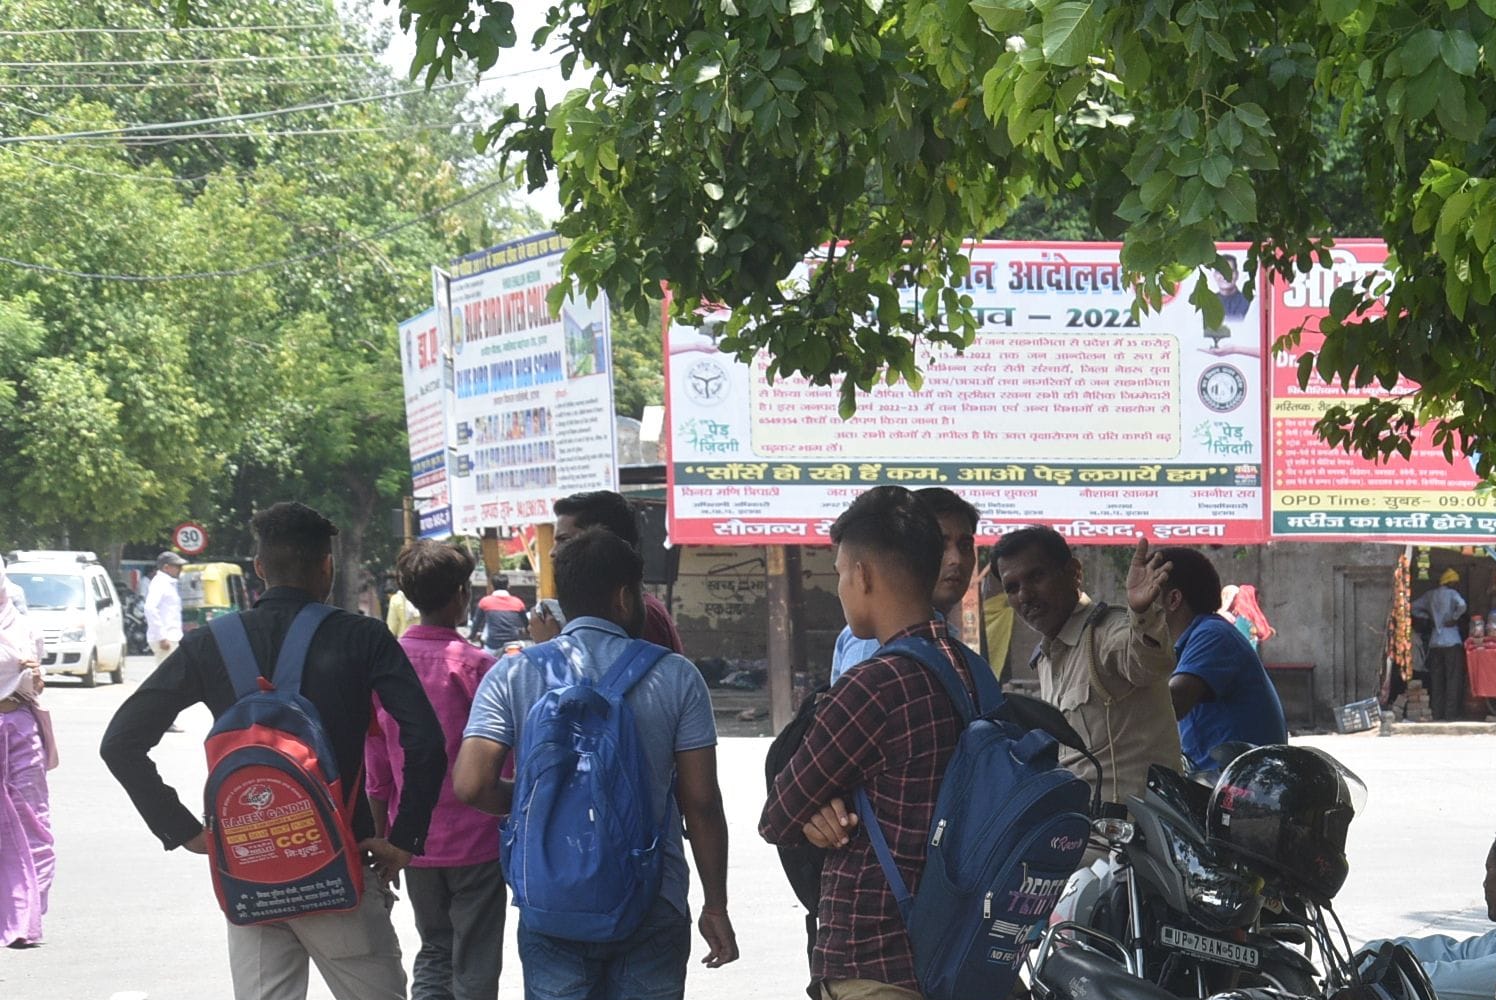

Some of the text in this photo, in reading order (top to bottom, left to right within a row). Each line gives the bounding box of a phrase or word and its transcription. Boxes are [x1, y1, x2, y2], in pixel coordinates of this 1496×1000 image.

[1066, 308, 1141, 328] 2022
[773, 463, 801, 481] हो
[809, 463, 850, 481] रही
[858, 463, 882, 482] हैं
[957, 464, 1026, 482] आओ
[1033, 465, 1073, 485] पेड़
[1078, 464, 1162, 482] लगायें
[1281, 495, 1321, 506] OPD
[1327, 494, 1376, 506] Time:
[712, 519, 807, 536] सौजन्य
[1153, 522, 1226, 537] इटावा
[1287, 512, 1345, 528] मरीज
[1349, 516, 1380, 528] का
[1384, 512, 1430, 529] भर्ती
[1432, 513, 1473, 530] होने
[180, 529, 199, 543] 30
[221, 809, 266, 829] RAJEEV
[266, 799, 312, 820] GANDHI
[276, 828, 321, 848] CCC
